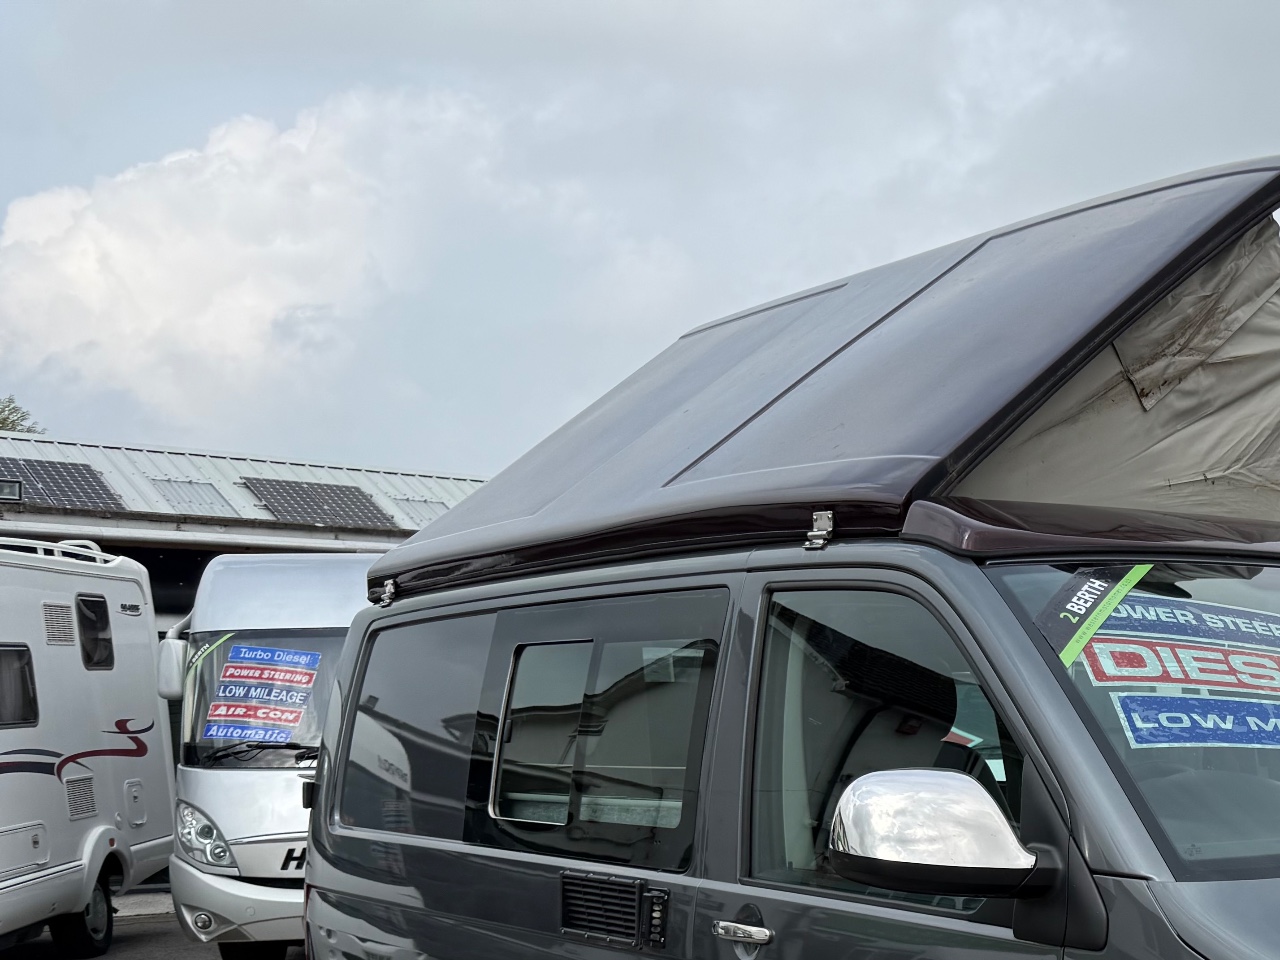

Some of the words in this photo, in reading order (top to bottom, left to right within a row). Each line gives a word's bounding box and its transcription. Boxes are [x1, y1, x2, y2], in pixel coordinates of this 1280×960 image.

[1066, 579, 1110, 614] BERTH
[1060, 612, 1079, 624] 2
[1110, 603, 1197, 625] OWER
[239, 648, 271, 659] Turbo
[274, 651, 311, 665] Diesel
[226, 667, 260, 677] POWER
[261, 669, 311, 682] STEERING
[218, 685, 248, 697] LOW
[248, 686, 309, 704] MILEAGE
[213, 705, 299, 720] AIR-CON
[1131, 712, 1233, 730] LOW
[207, 725, 289, 741] Automatic
